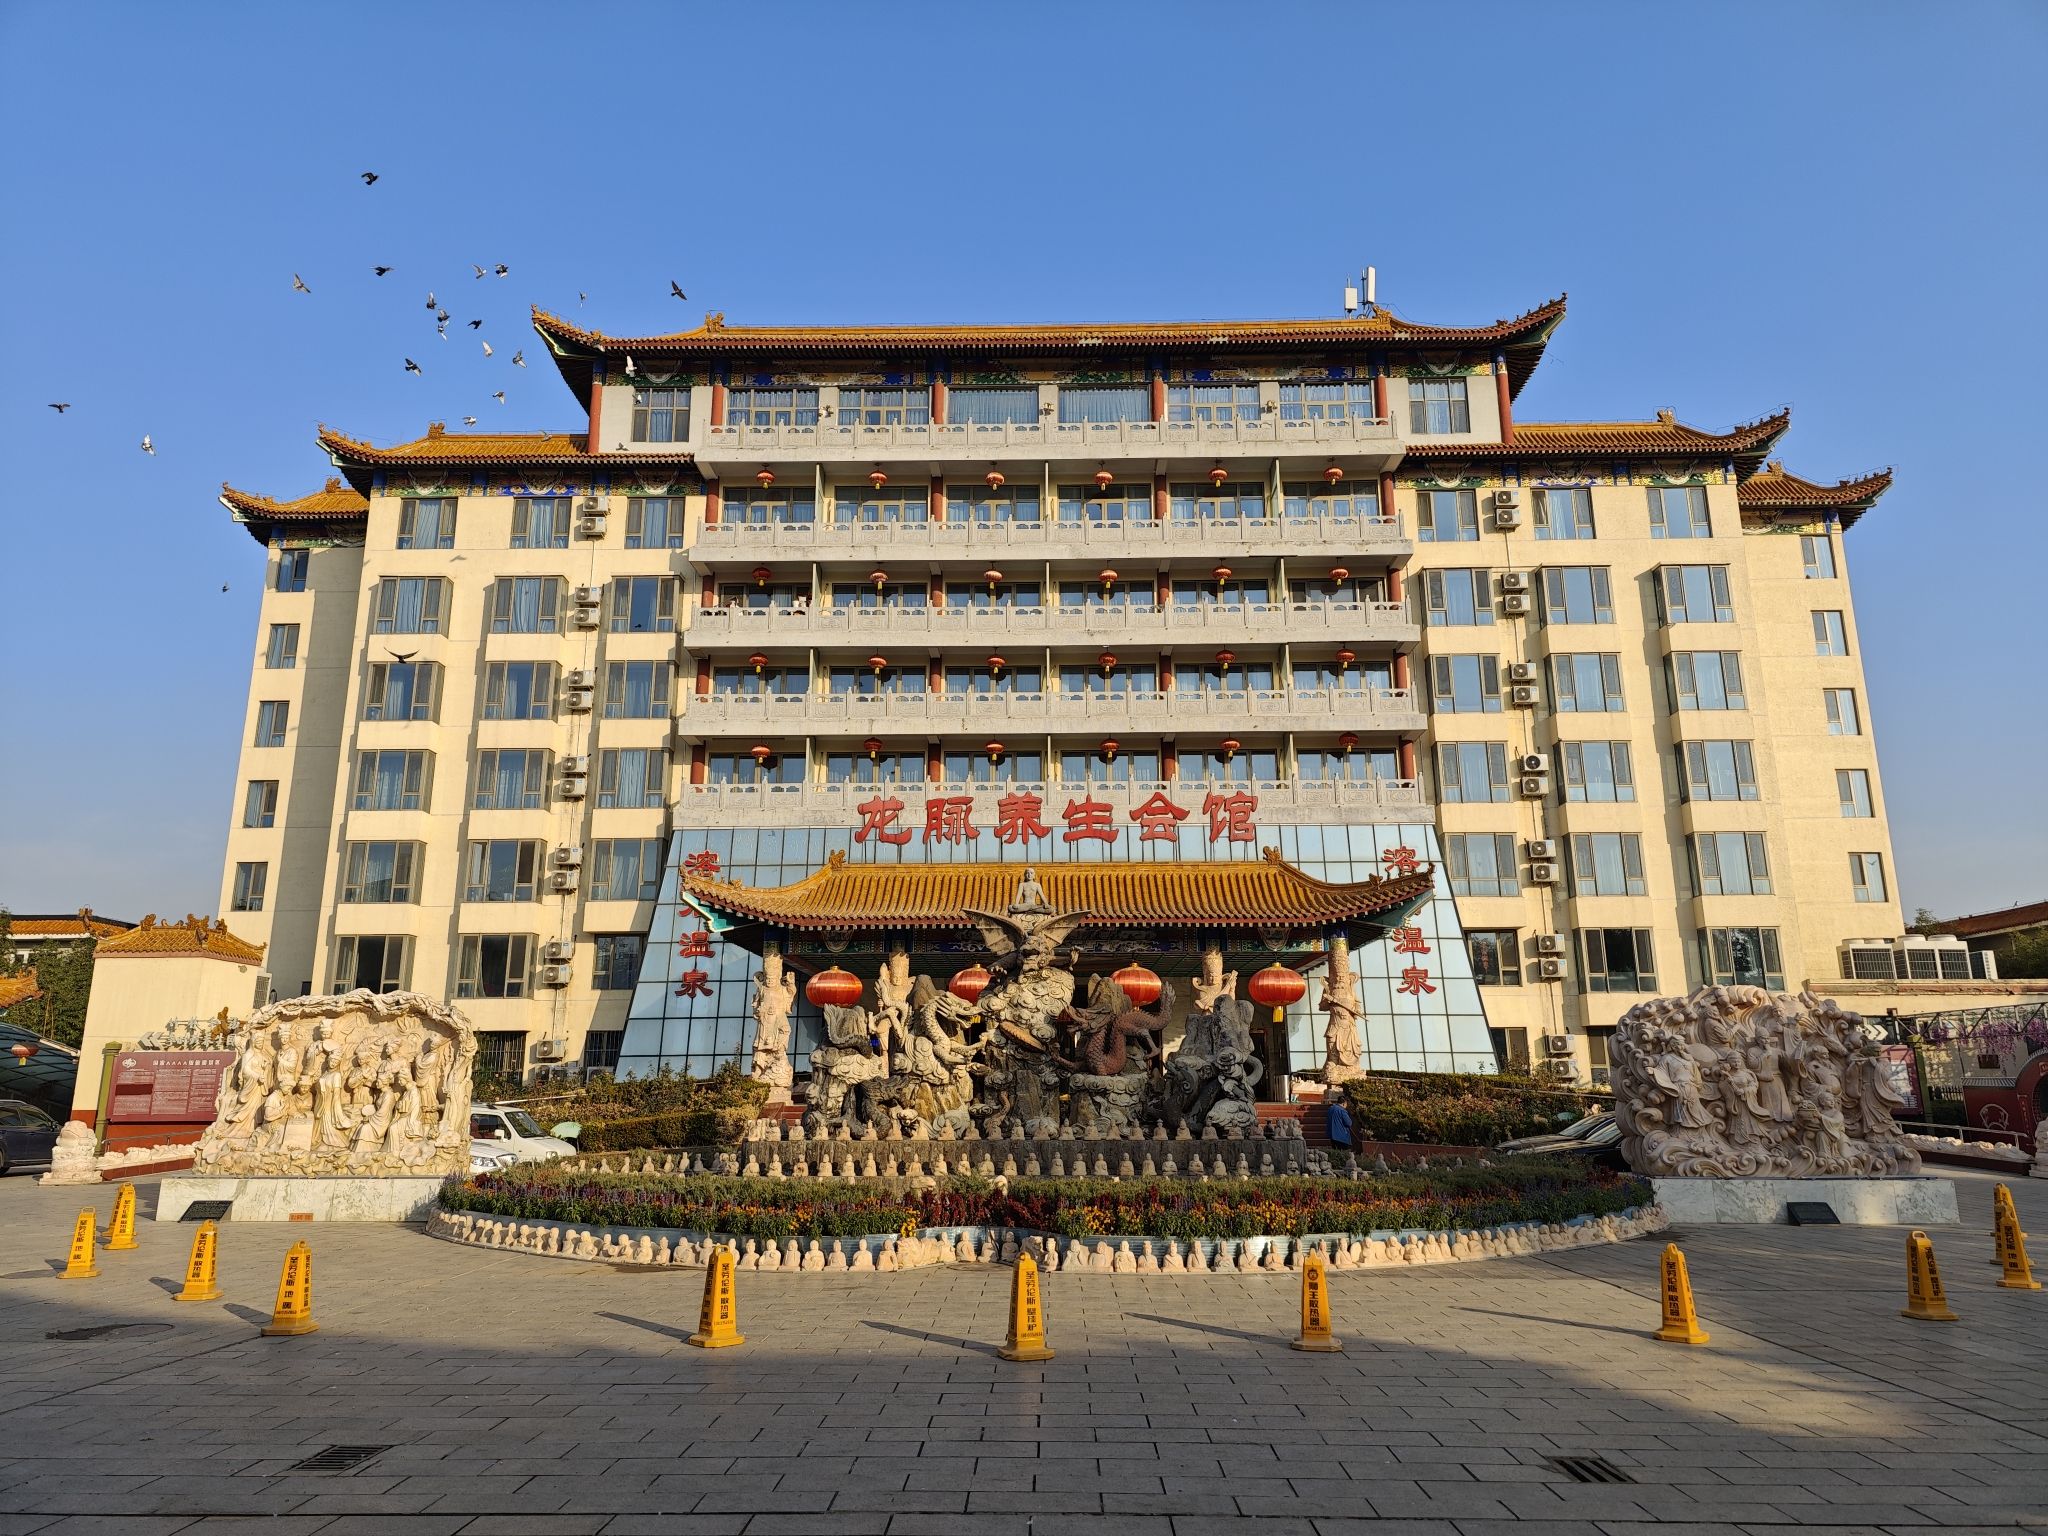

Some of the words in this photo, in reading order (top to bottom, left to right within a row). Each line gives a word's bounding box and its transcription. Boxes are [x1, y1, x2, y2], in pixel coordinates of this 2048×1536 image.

[855, 791, 1258, 846] 龙脉养生会馆
[675, 850, 721, 998] 溶温泉
[1382, 846, 1438, 996] 溶温泉
